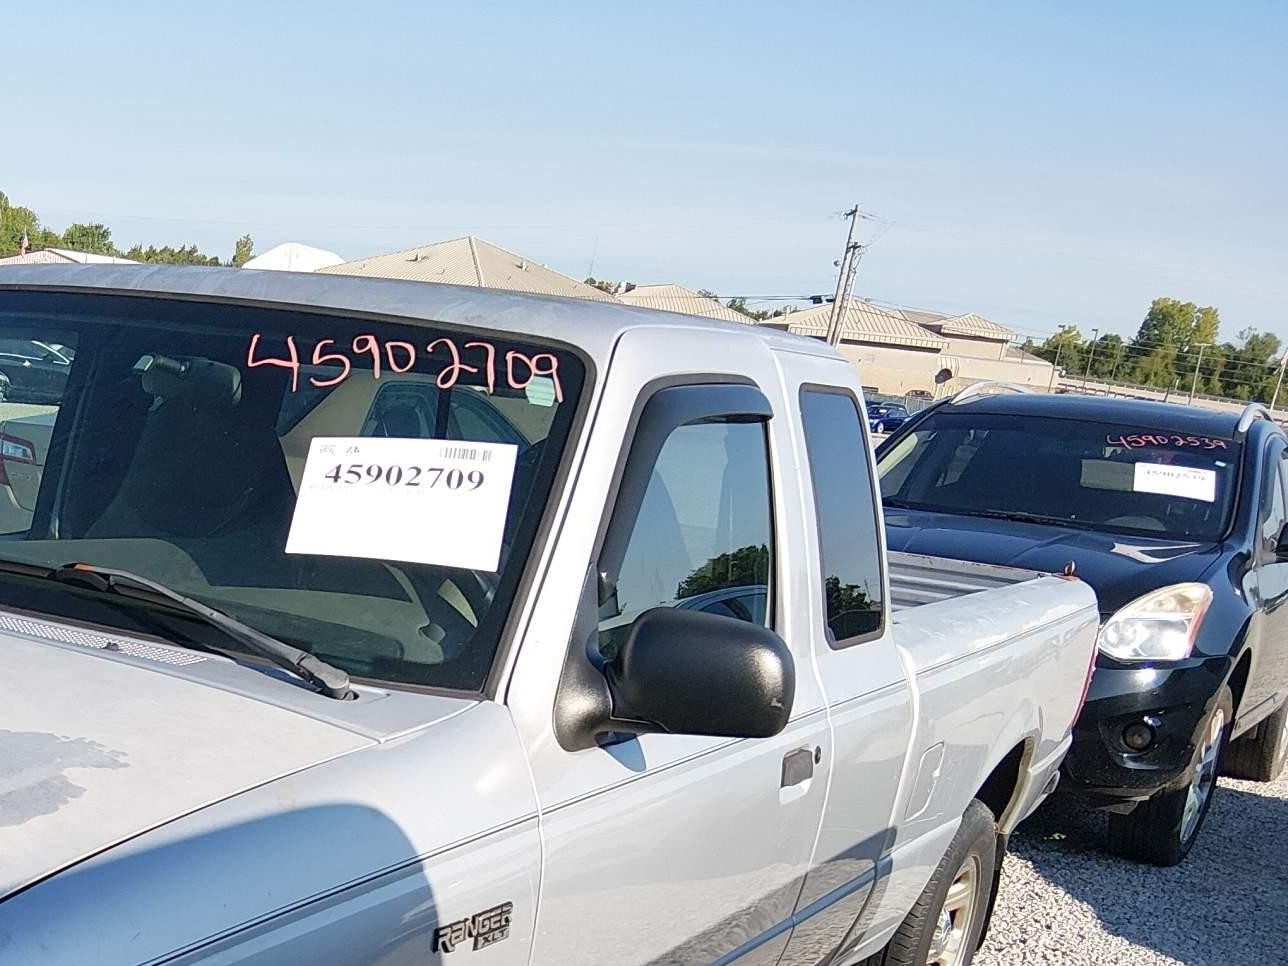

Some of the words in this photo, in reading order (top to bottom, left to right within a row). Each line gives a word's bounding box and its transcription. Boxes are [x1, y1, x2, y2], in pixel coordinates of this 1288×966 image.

[247, 333, 564, 403] 45902709
[324, 462, 486, 492] 45902709
[431, 901, 513, 954] RANGER
